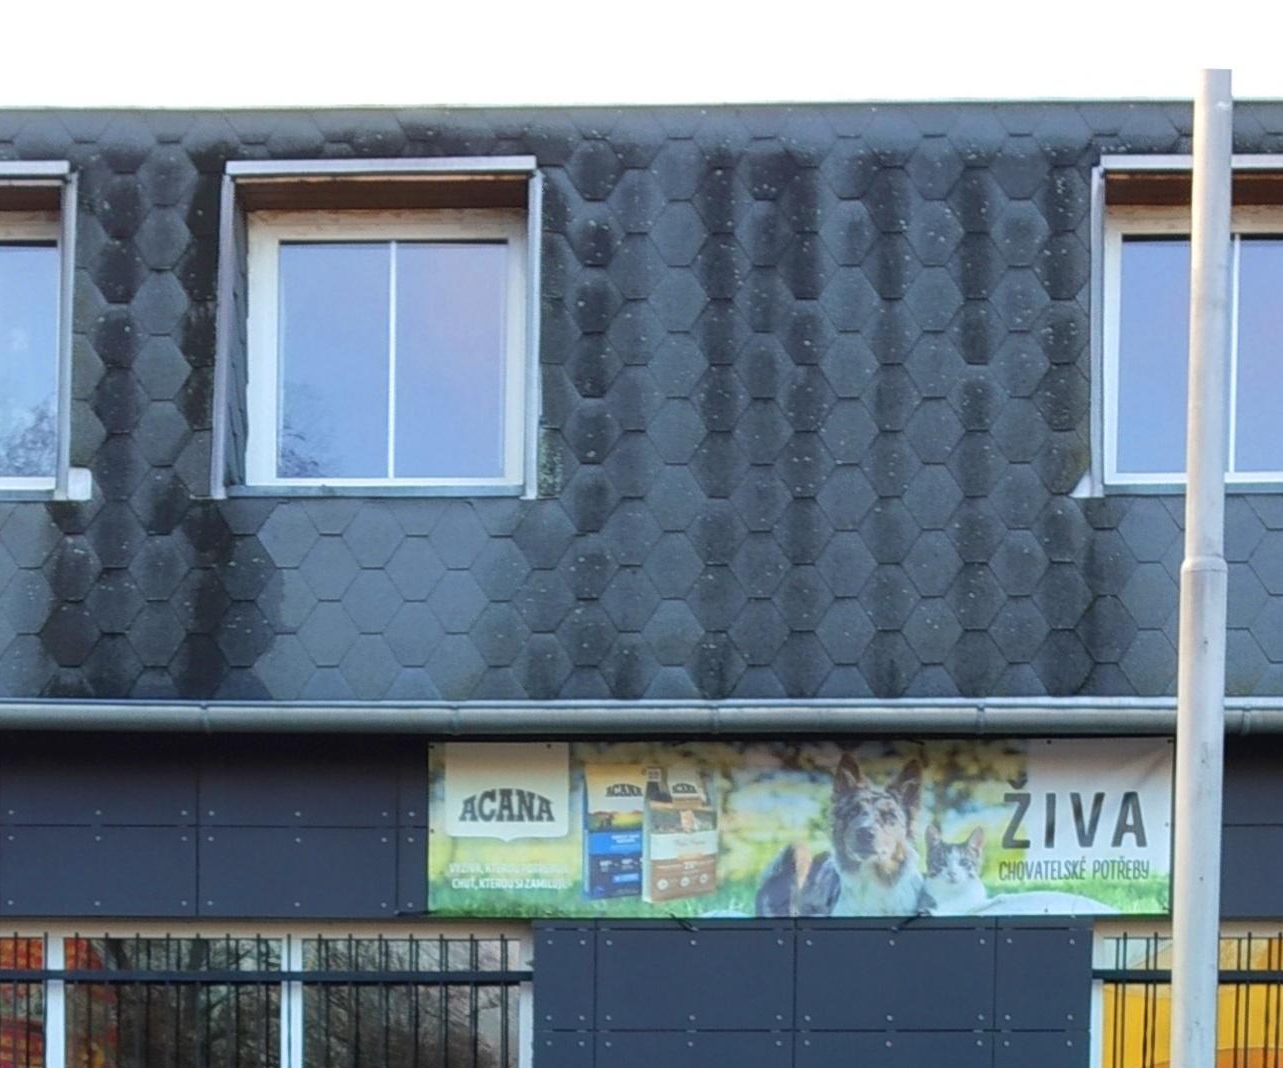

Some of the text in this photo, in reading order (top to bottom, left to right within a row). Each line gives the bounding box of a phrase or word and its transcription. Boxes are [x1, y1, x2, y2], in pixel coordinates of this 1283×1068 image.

[458, 788, 555, 822] ACANA
[1002, 779, 1147, 848] ŽIVA
[999, 856, 1150, 880] CHOVATELSKÉ POTŘEBY
